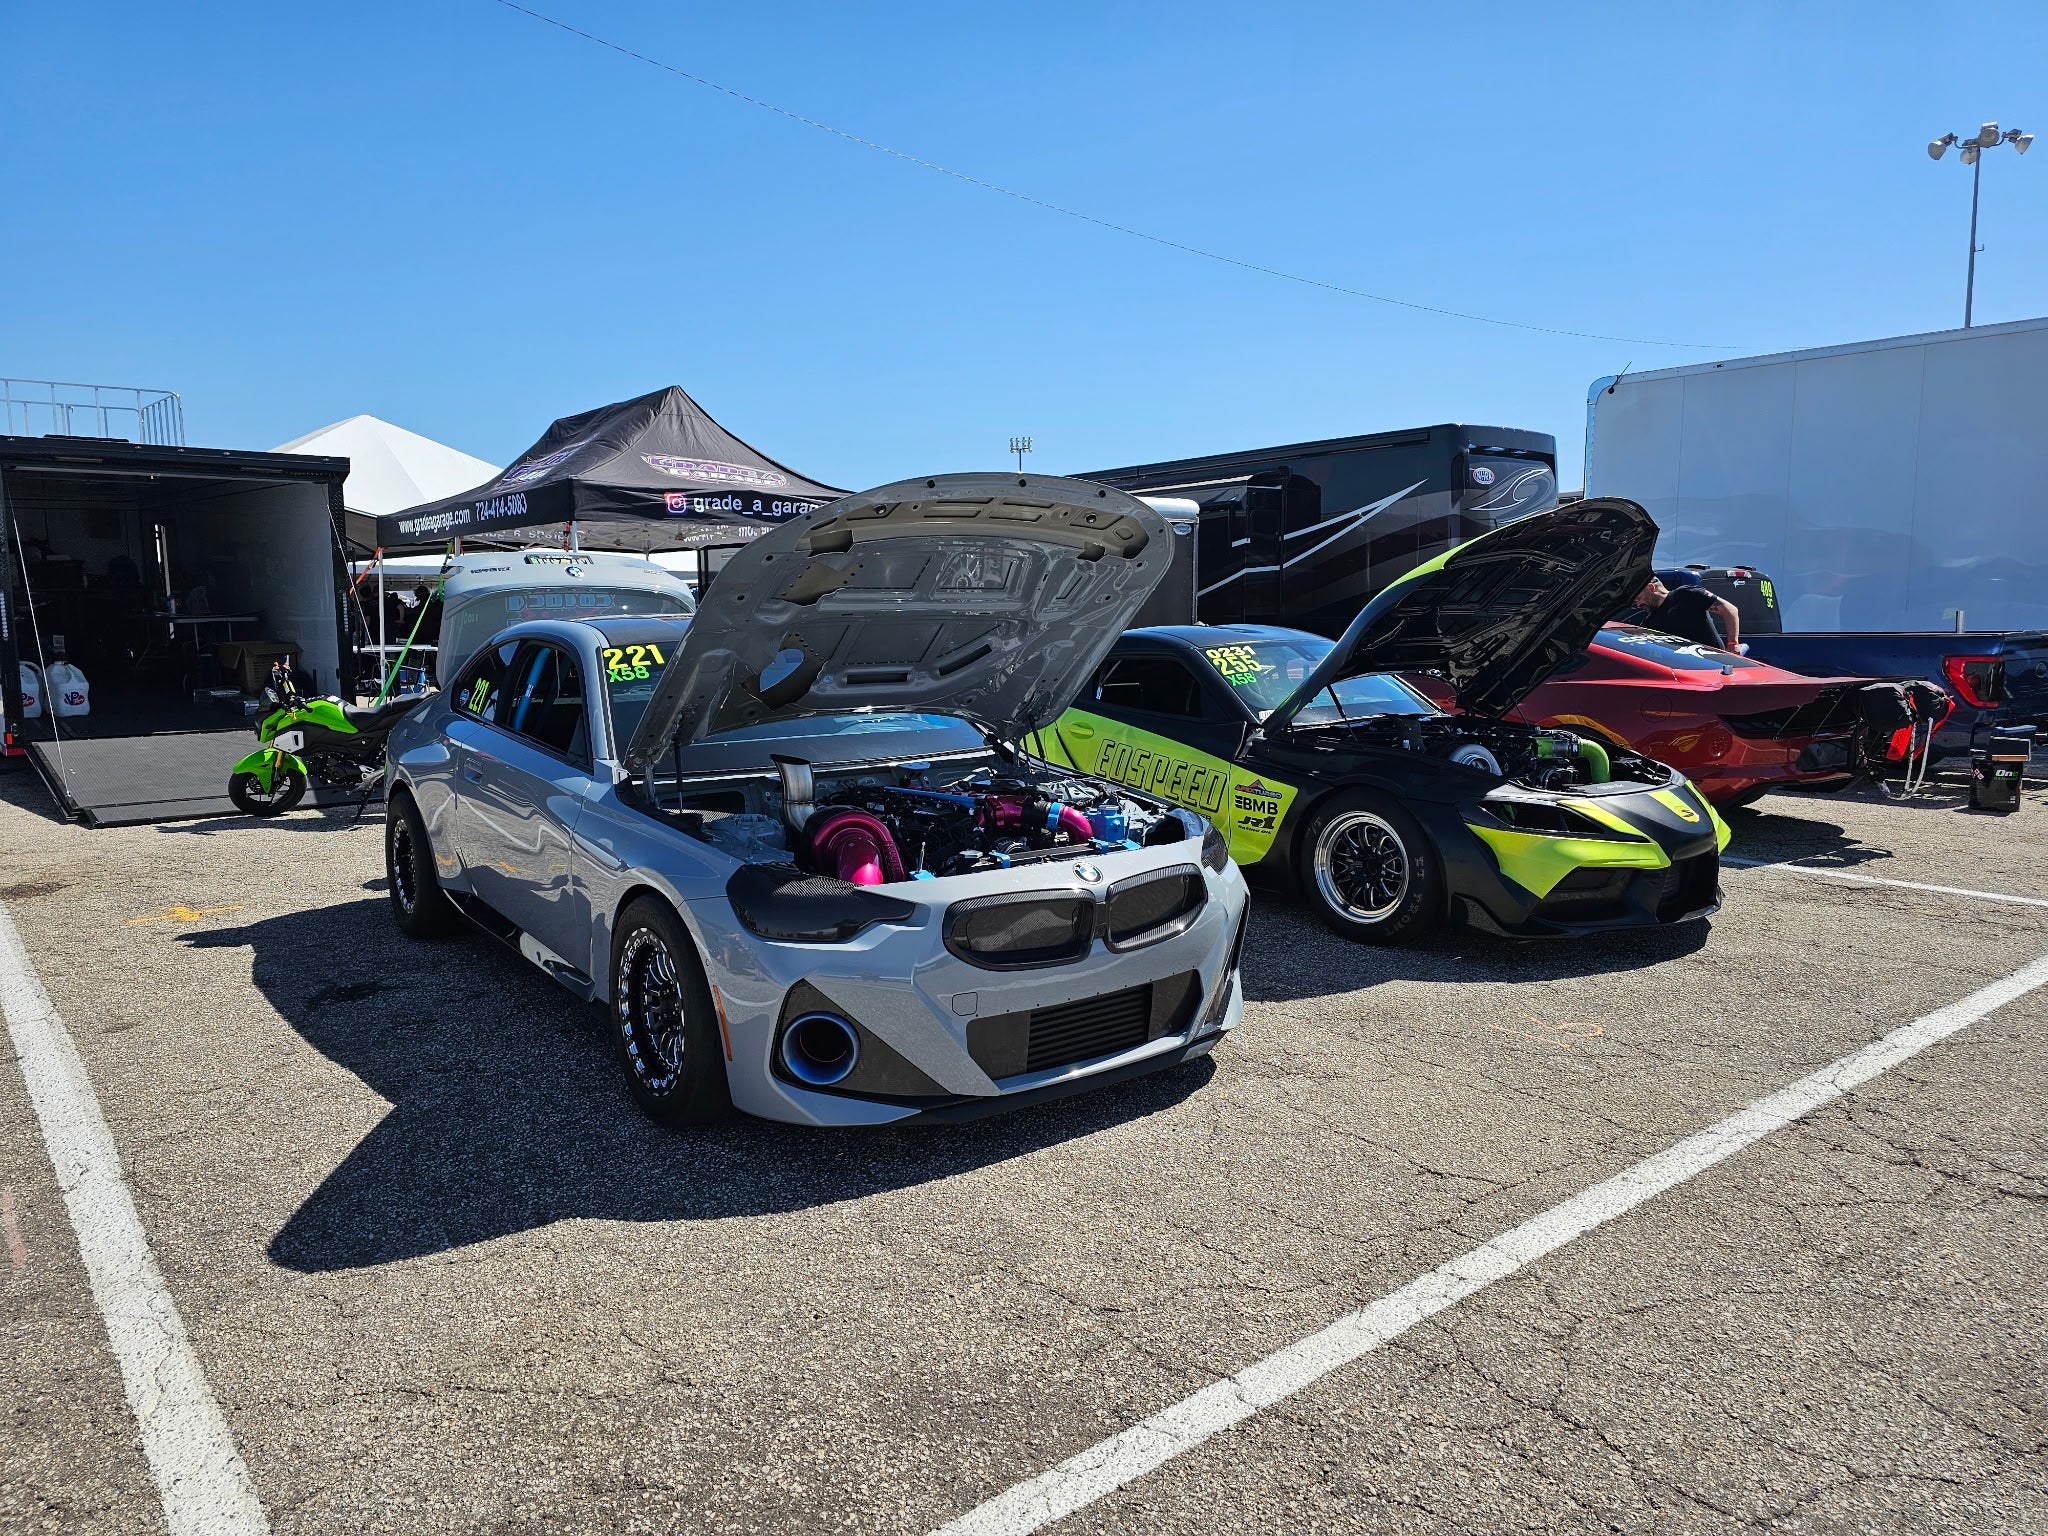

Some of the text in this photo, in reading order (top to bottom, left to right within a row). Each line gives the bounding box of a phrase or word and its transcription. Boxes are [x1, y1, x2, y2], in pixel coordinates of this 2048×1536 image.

[398, 507, 472, 537] www.gradeagarage.com
[475, 492, 529, 522] 724-414-5083
[693, 494, 820, 518] grade_a_gara
[602, 644, 665, 670] 221
[1205, 645, 1256, 659] 0231
[605, 665, 650, 683] X58
[1212, 654, 1262, 676] 255
[1225, 672, 1257, 687] X58
[468, 677, 490, 714] 221
